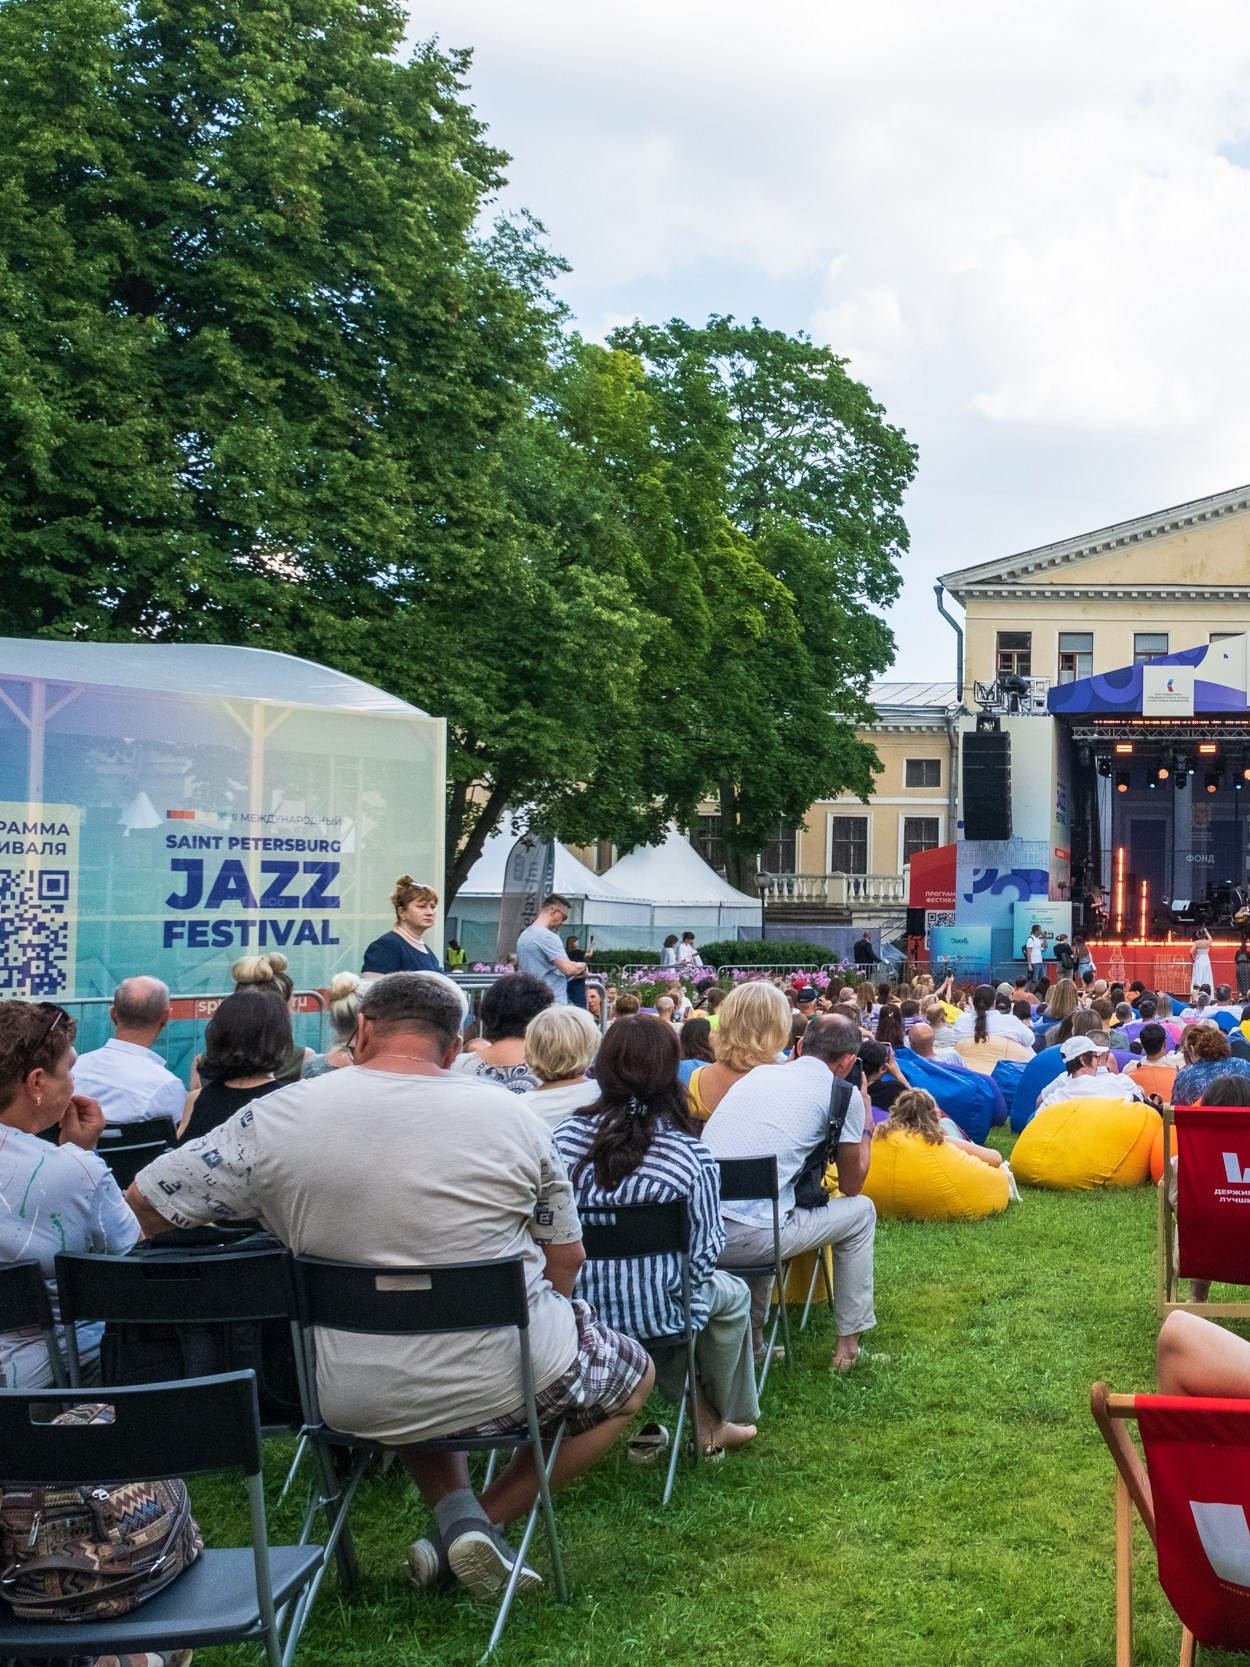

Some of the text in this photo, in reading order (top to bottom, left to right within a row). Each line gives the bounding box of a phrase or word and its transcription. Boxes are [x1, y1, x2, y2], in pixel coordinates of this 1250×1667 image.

[166, 834, 341, 853] SAINT PETERSBURG
[1186, 854, 1215, 864] ФОНД
[165, 858, 341, 910] JAZZ
[163, 919, 341, 948] FESTIVAL
